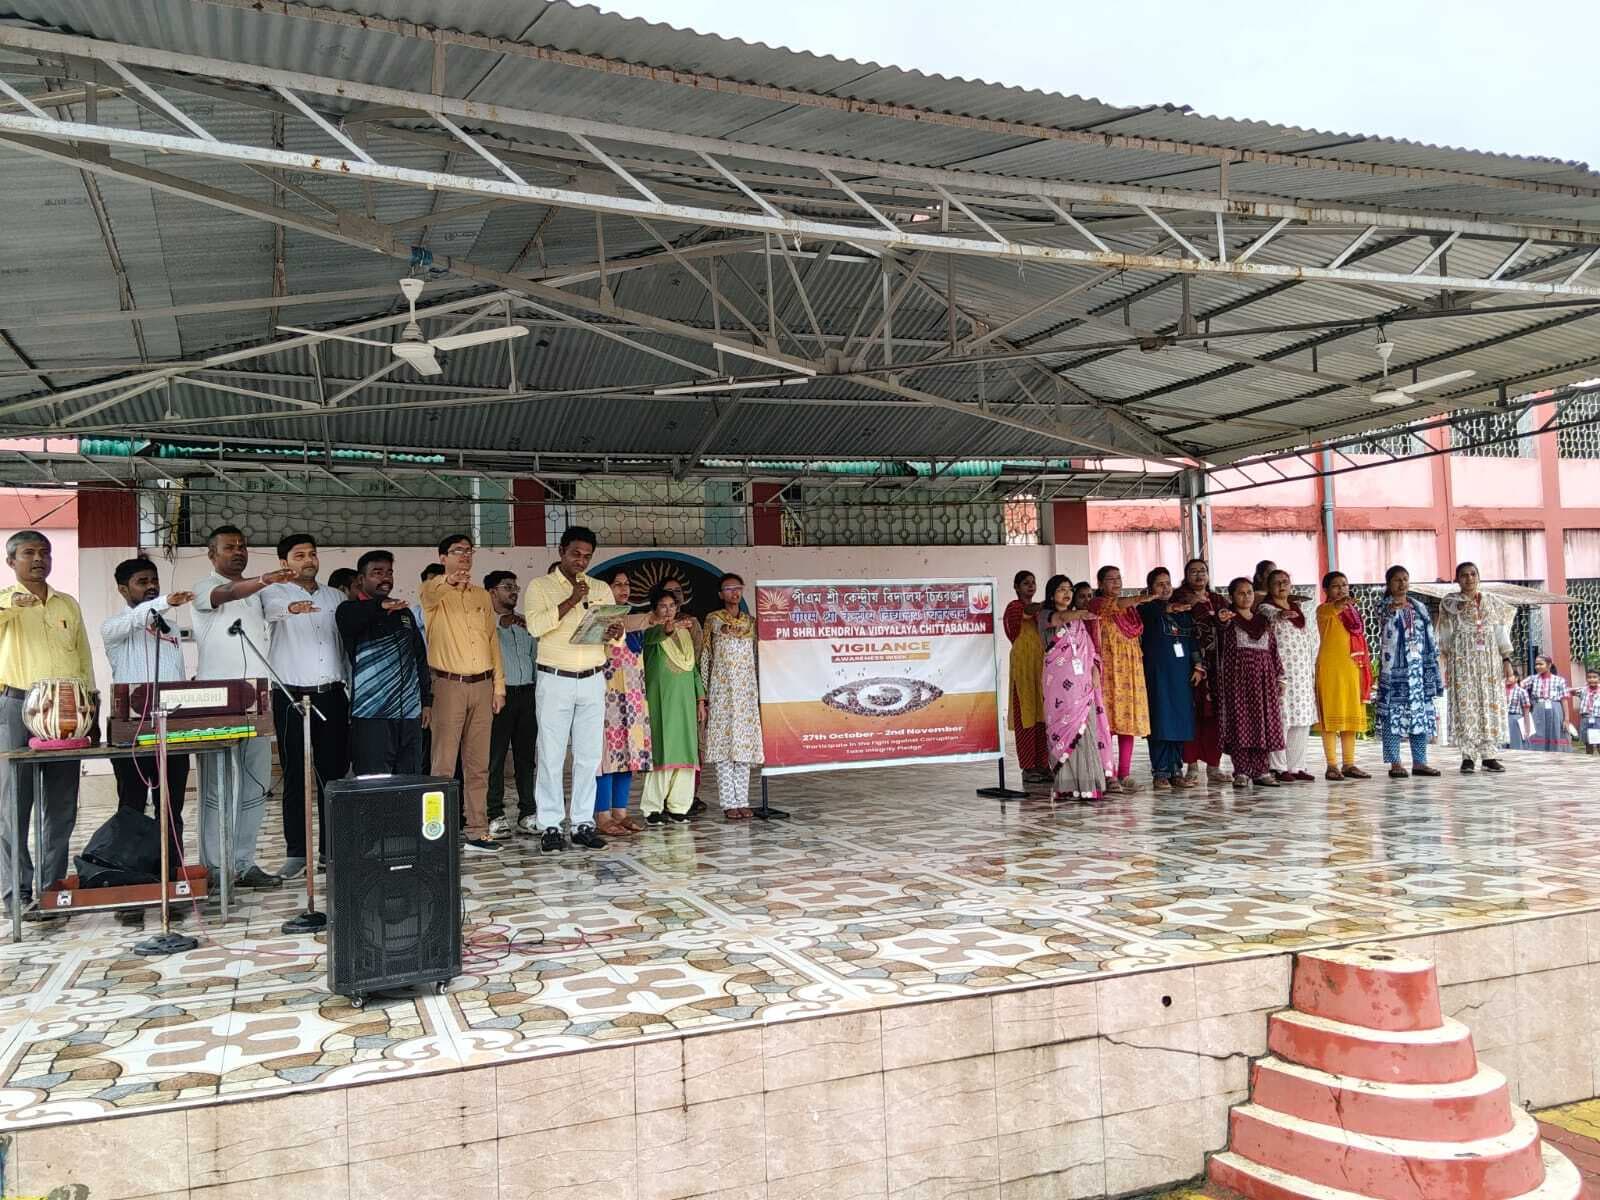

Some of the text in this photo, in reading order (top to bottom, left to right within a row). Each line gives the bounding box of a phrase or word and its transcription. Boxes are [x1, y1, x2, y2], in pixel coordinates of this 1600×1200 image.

[776, 622, 986, 638] PM SHRI KENDRIYA VIDYALAYA CHITTARANJAN
[831, 641, 930, 653] VIGILANCE
[829, 732, 873, 740] October
[885, 728, 904, 736] 2nd
[907, 726, 964, 735] November
